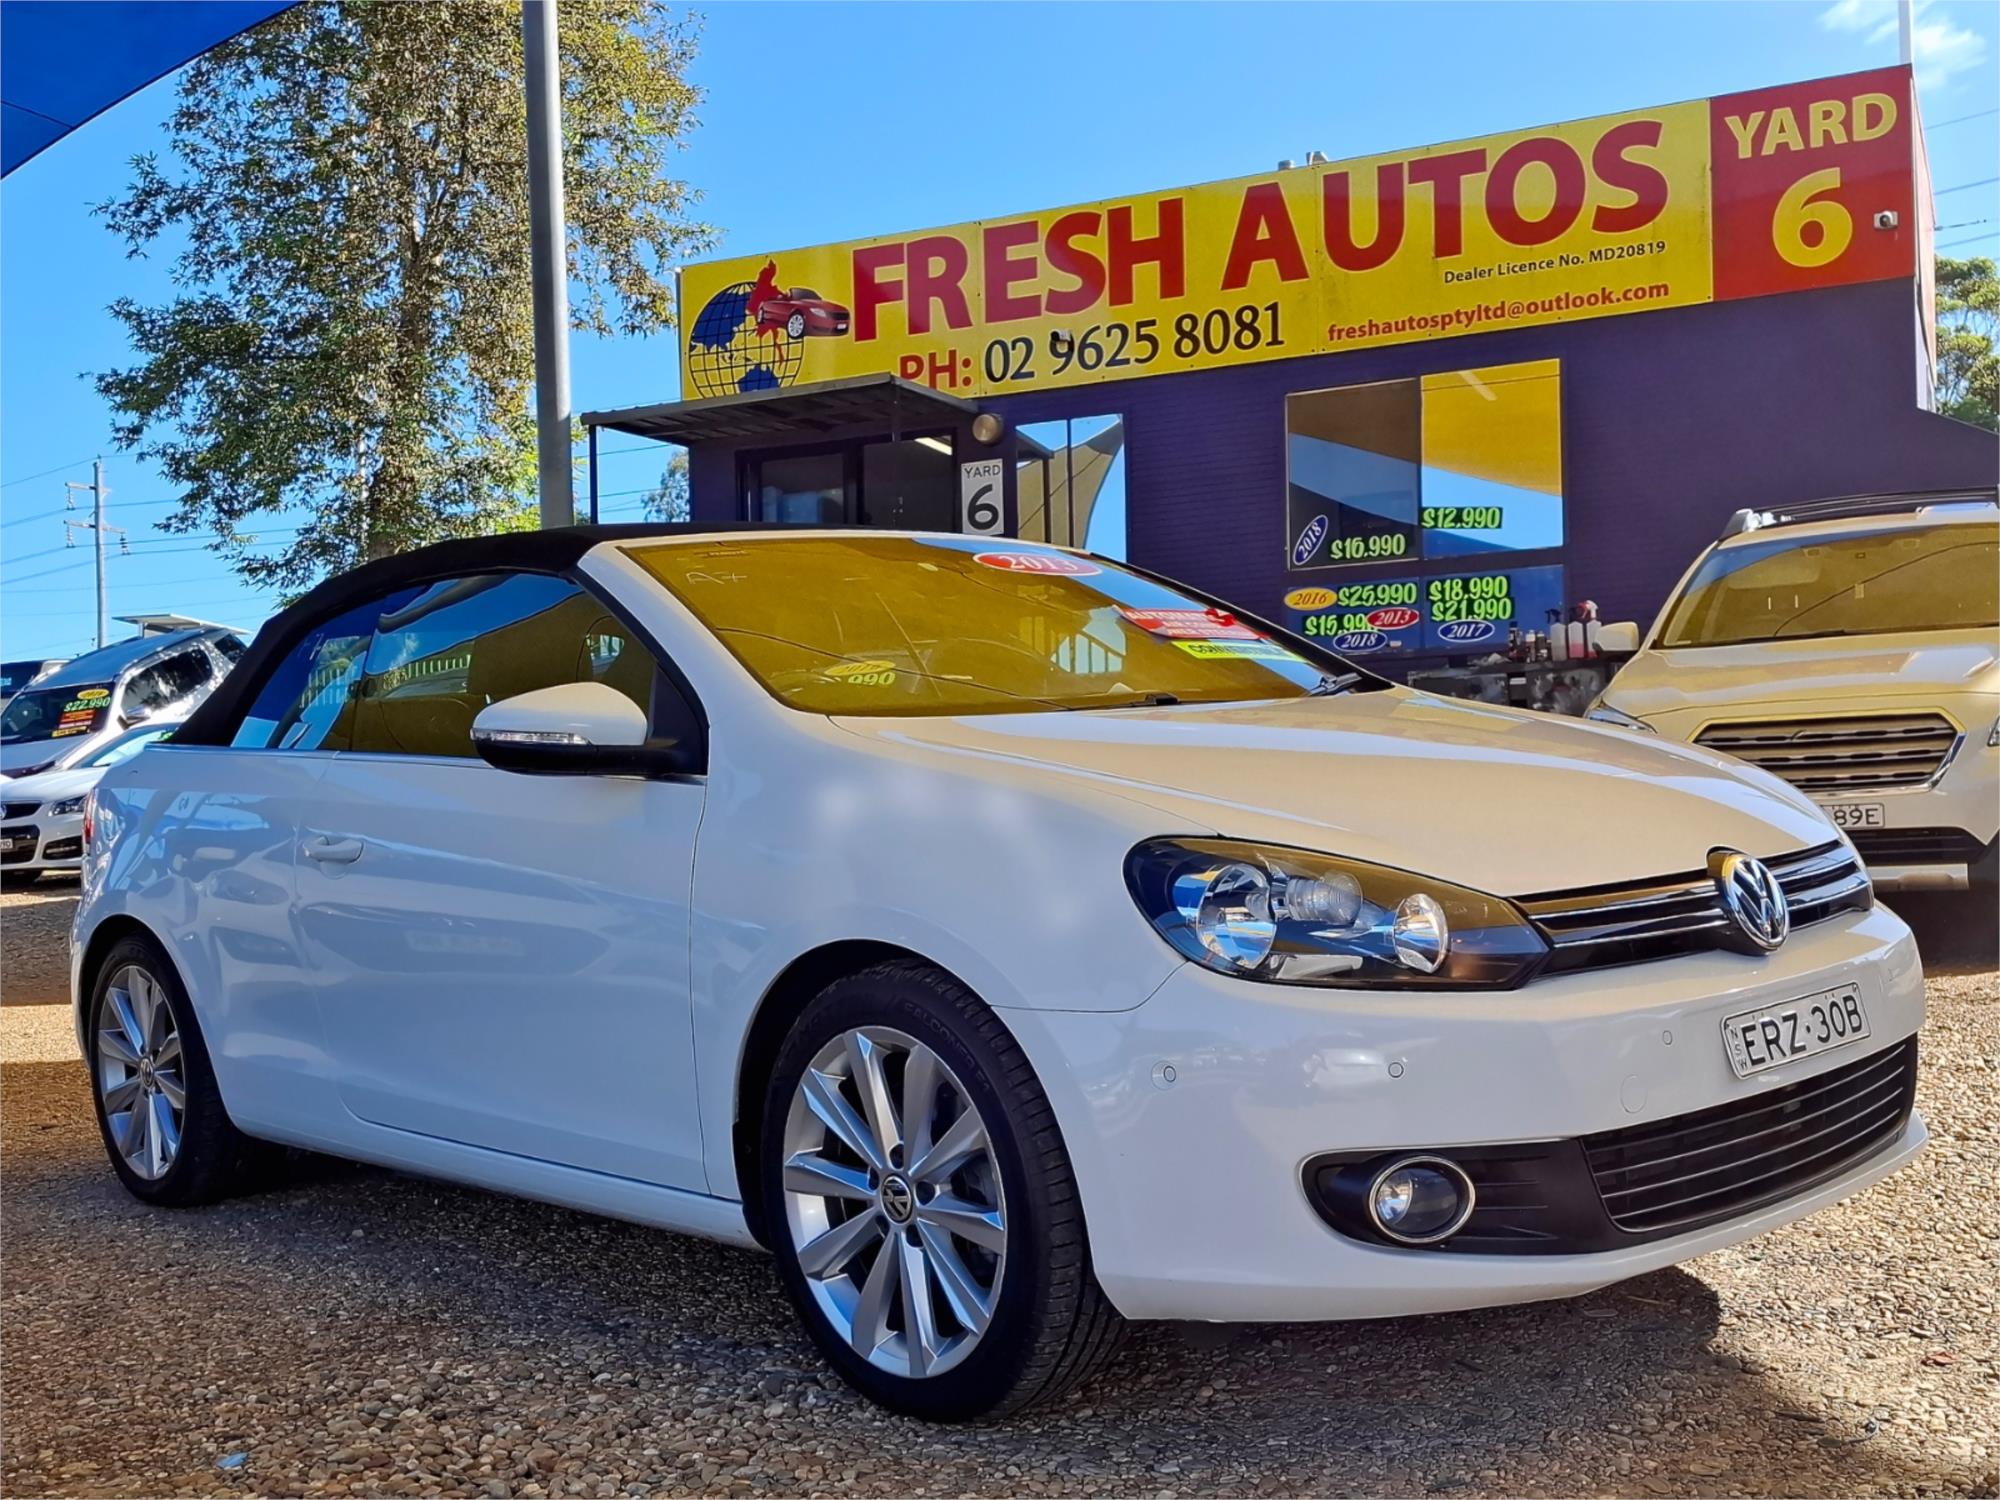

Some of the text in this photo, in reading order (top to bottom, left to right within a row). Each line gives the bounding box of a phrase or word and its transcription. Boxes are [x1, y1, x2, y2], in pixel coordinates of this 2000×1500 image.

[1724, 92, 1897, 159] YARD
[852, 120, 1669, 343] FRESH AUTOS
[1772, 167, 1853, 268] 6
[1444, 240, 1666, 284] Dealer Licence No. MD20819
[1328, 282, 1669, 342] freshautosptyltd@outlook.com
[900, 301, 1286, 391] PH: 02 9625 8081
[964, 465, 1001, 478] YARD
[968, 483, 999, 530] 6
[1297, 520, 1323, 560] 2018
[1294, 592, 1329, 605] 2016
[1374, 610, 1411, 625] 2013
[1340, 631, 1378, 648] 2018
[1447, 626, 1485, 639] 2017
